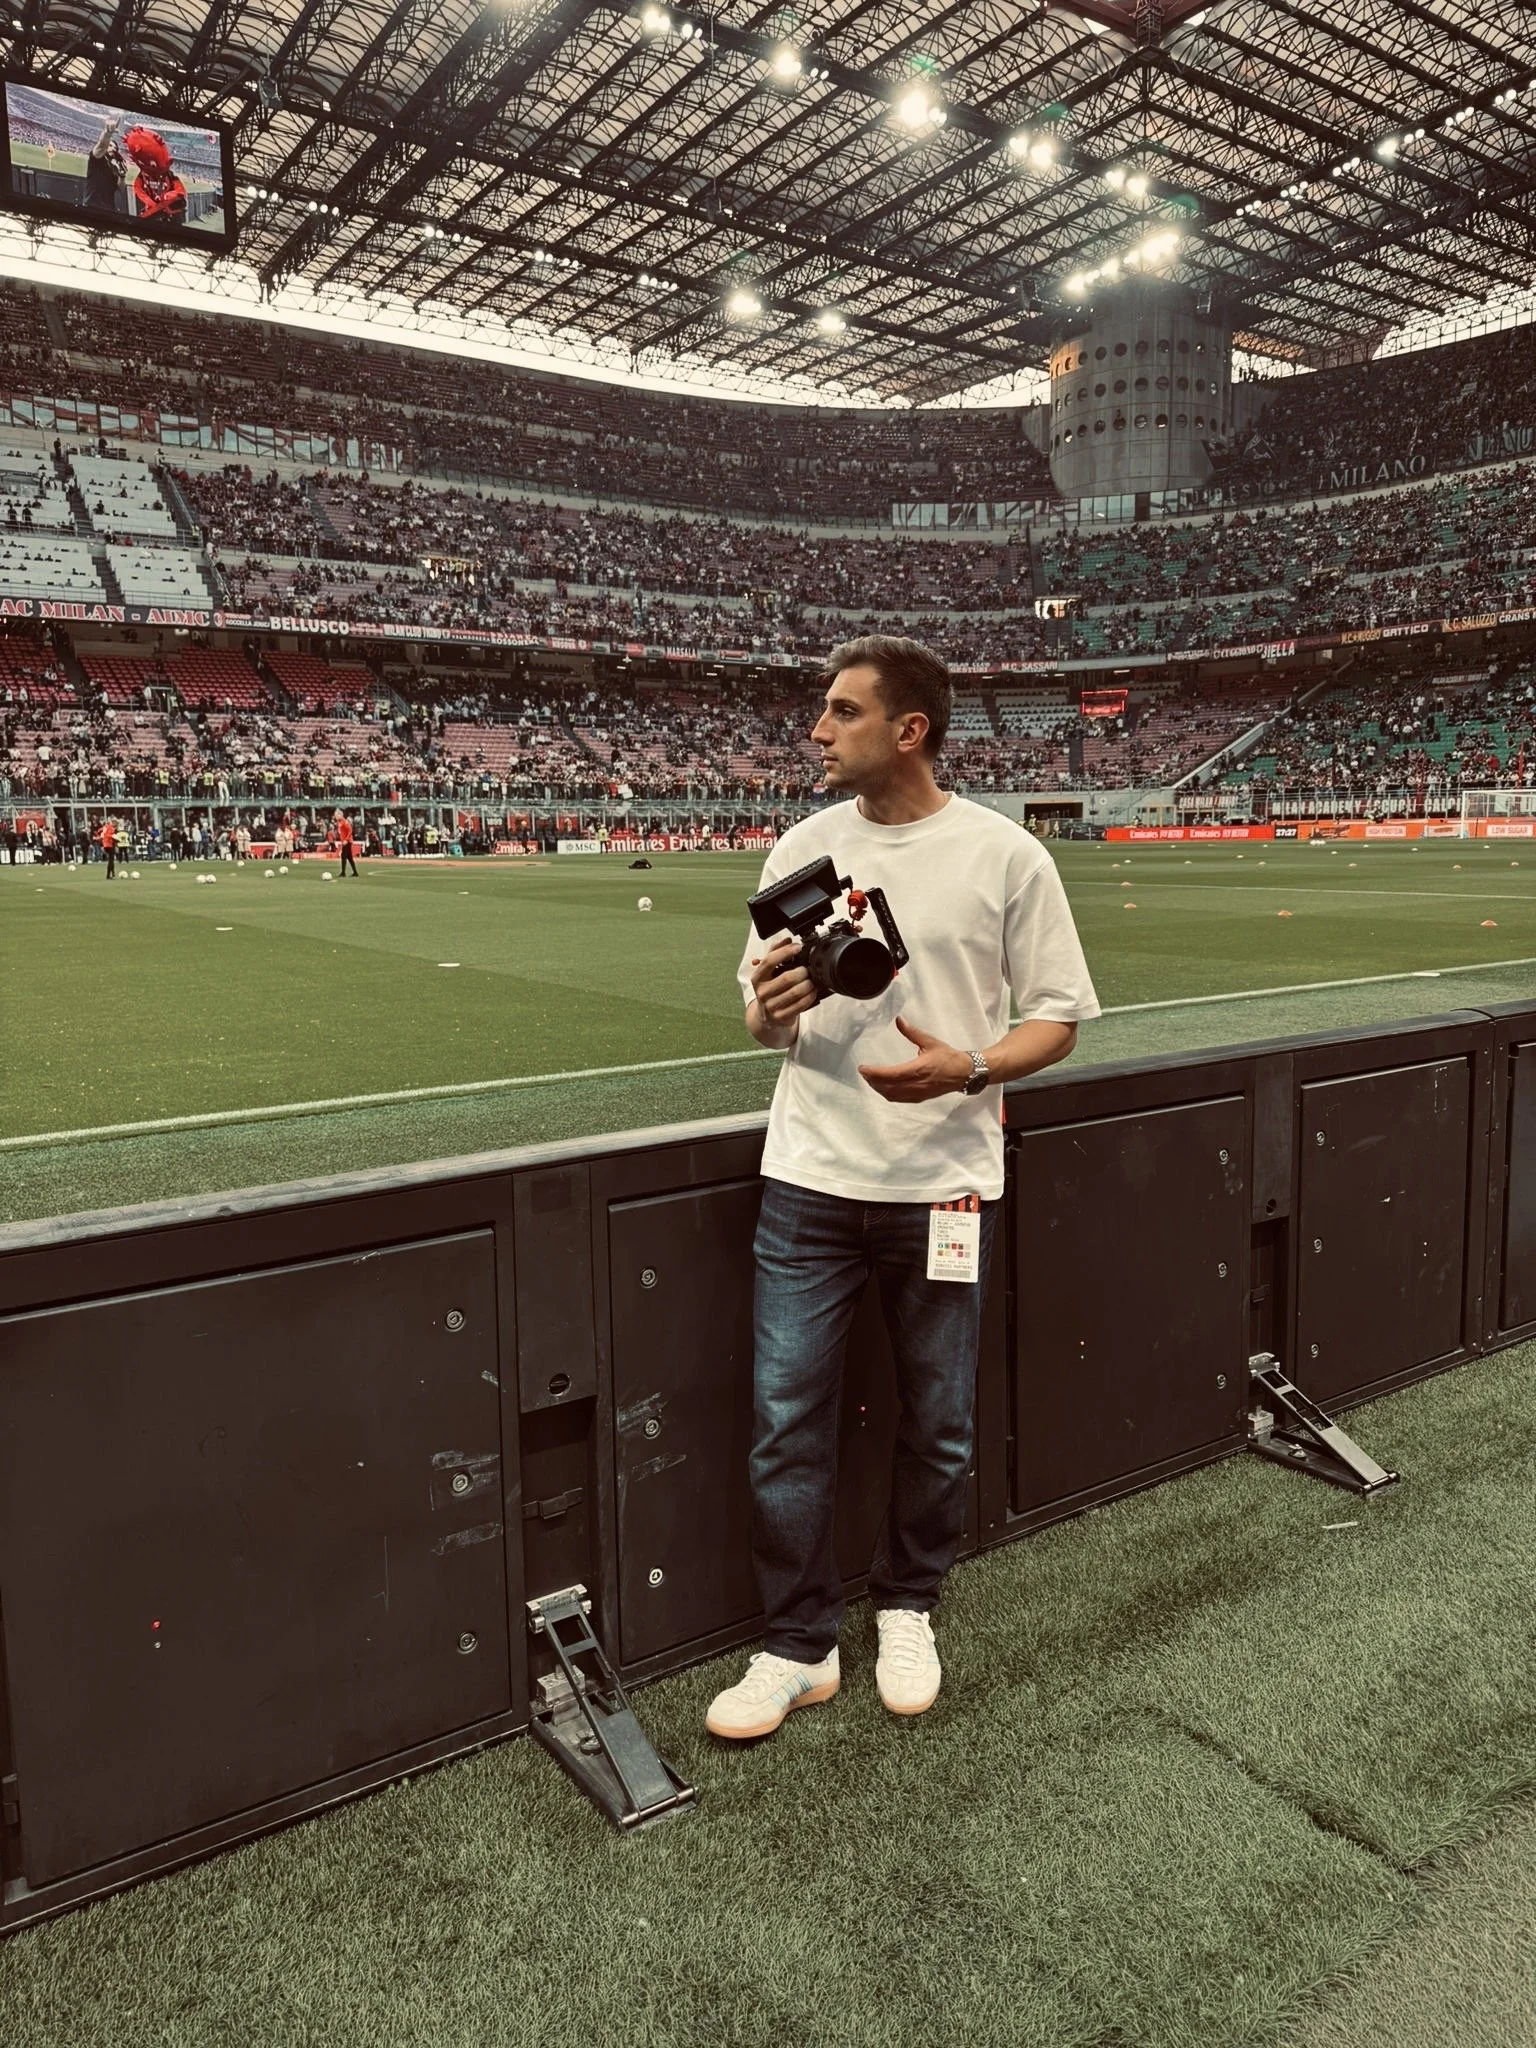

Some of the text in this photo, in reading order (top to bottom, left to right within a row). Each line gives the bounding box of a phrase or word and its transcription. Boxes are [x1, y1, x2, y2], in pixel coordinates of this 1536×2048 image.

[1330, 455, 1426, 489] MILANO
[0, 599, 34, 616] AC
[39, 601, 125, 622] MILAN
[146, 608, 210, 626] AIMC
[269, 616, 350, 635] BELLUSCO
[1383, 623, 1429, 638] GATTICO
[495, 840, 537, 854] Emiraes
[575, 843, 596, 851] MSC
[669, 836, 730, 850] Emirtes
